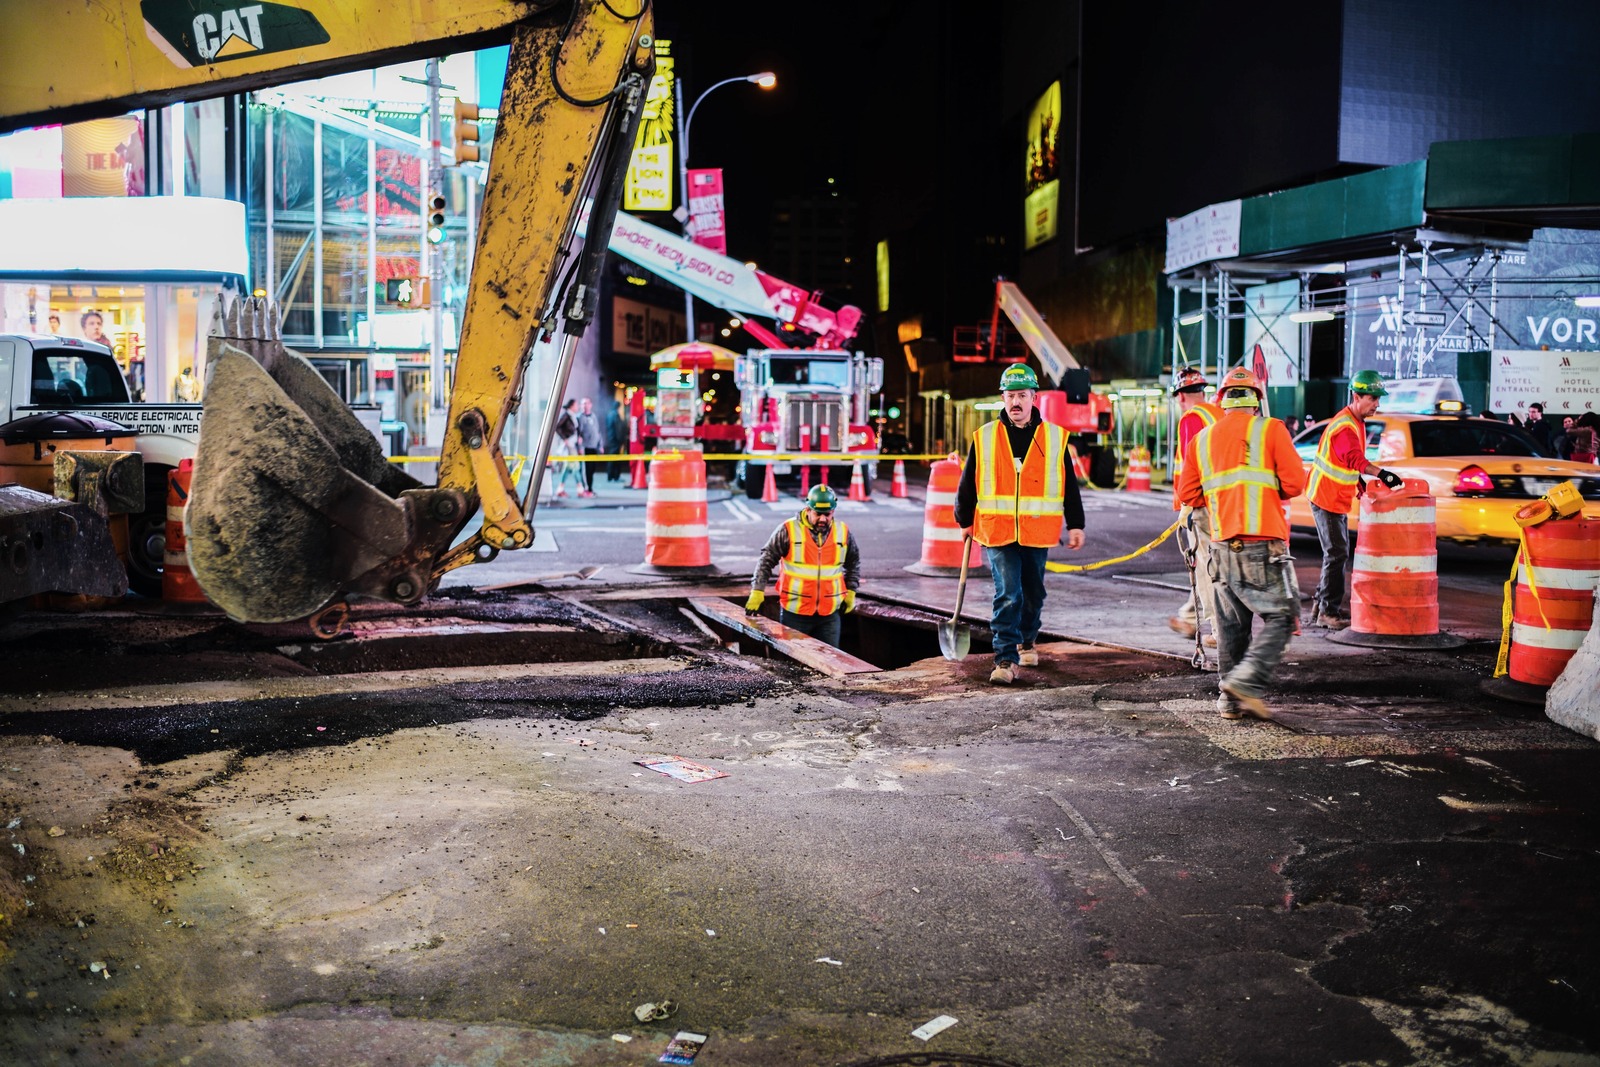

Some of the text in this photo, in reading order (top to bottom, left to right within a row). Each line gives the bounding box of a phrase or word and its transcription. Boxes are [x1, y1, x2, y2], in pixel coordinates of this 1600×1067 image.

[192, 4, 264, 59] CAT
[86, 152, 107, 170] THE
[637, 153, 659, 165] THE
[631, 166, 664, 183] LION
[631, 186, 665, 206] KING
[614, 225, 735, 287] SHORE NEON SIGN CO.
[1488, 253, 1526, 265] SUARE
[1526, 315, 1597, 345] VOR
[101, 411, 138, 421] SERVICE
[141, 411, 194, 421] ELECTRICAL
[172, 424, 199, 434] INTER
